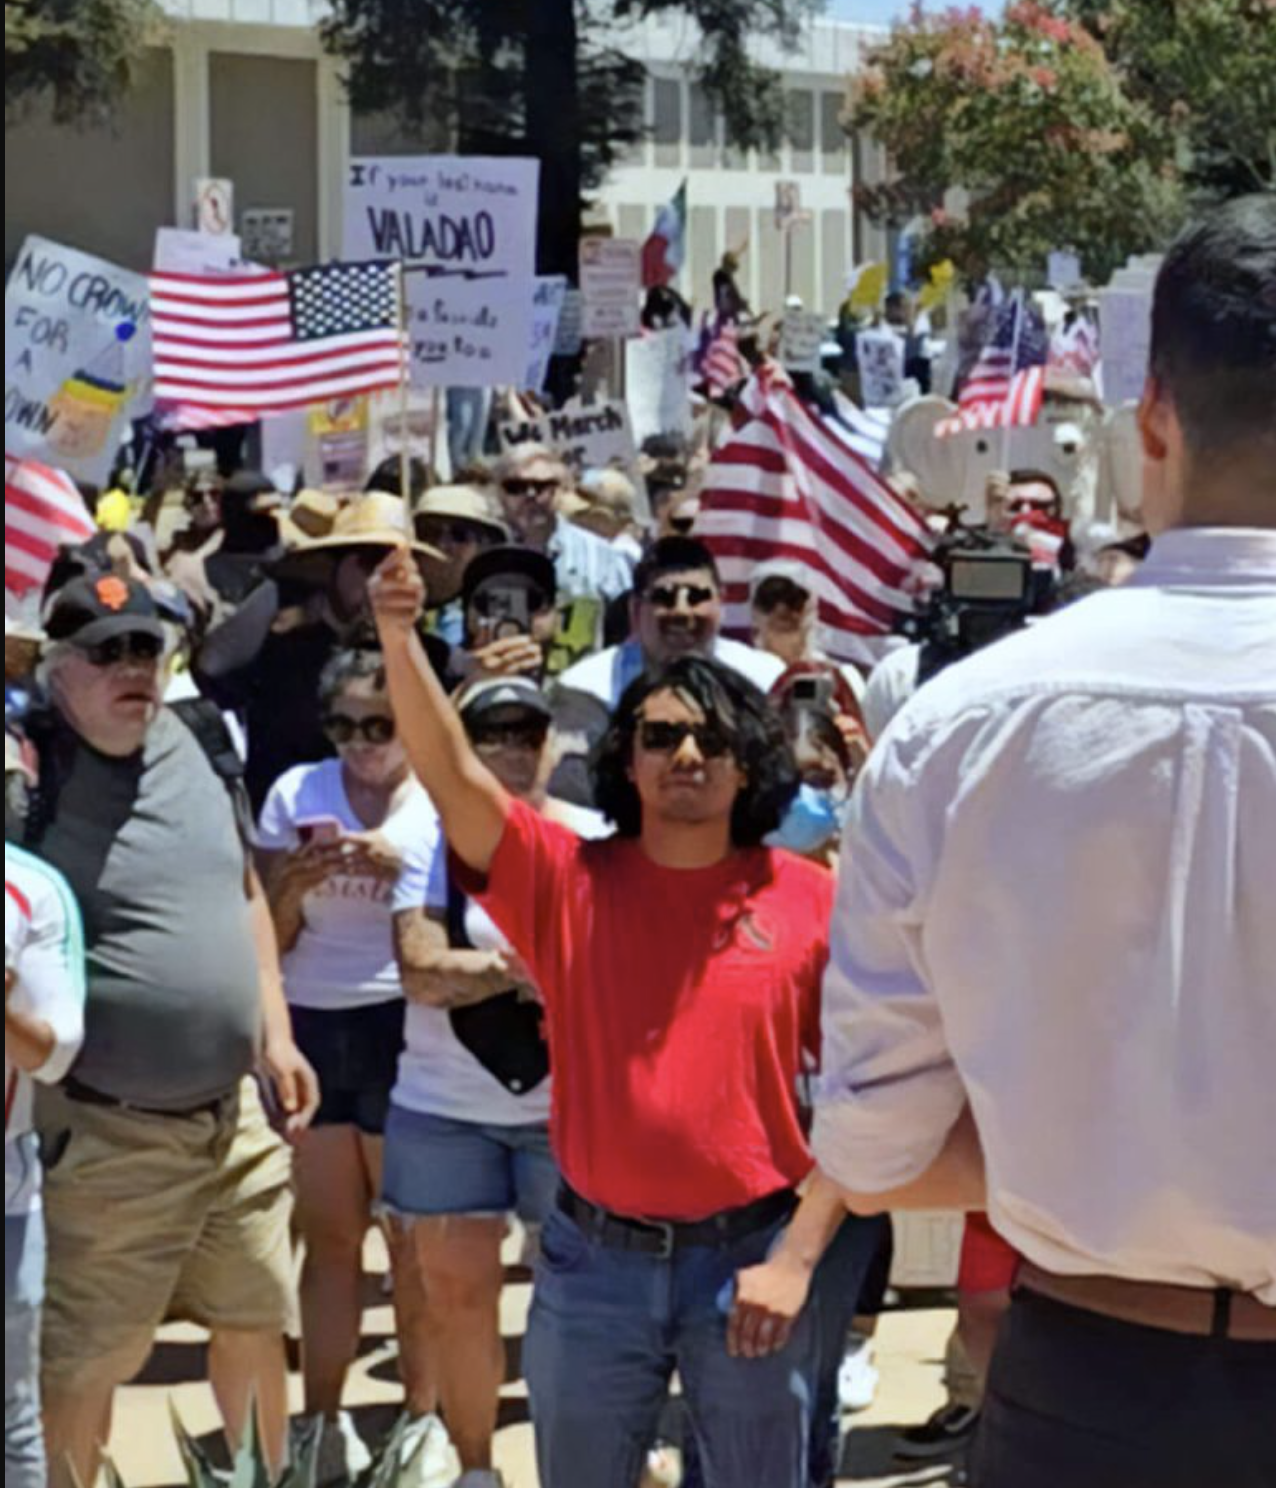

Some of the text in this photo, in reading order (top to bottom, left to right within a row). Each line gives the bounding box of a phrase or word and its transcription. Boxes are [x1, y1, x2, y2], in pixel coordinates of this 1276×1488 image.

[366, 205, 496, 263] VALADAO
[19, 251, 68, 296] NO
[14, 306, 70, 355] FOR
[13, 347, 33, 374] A
[5, 388, 59, 435] OWN
